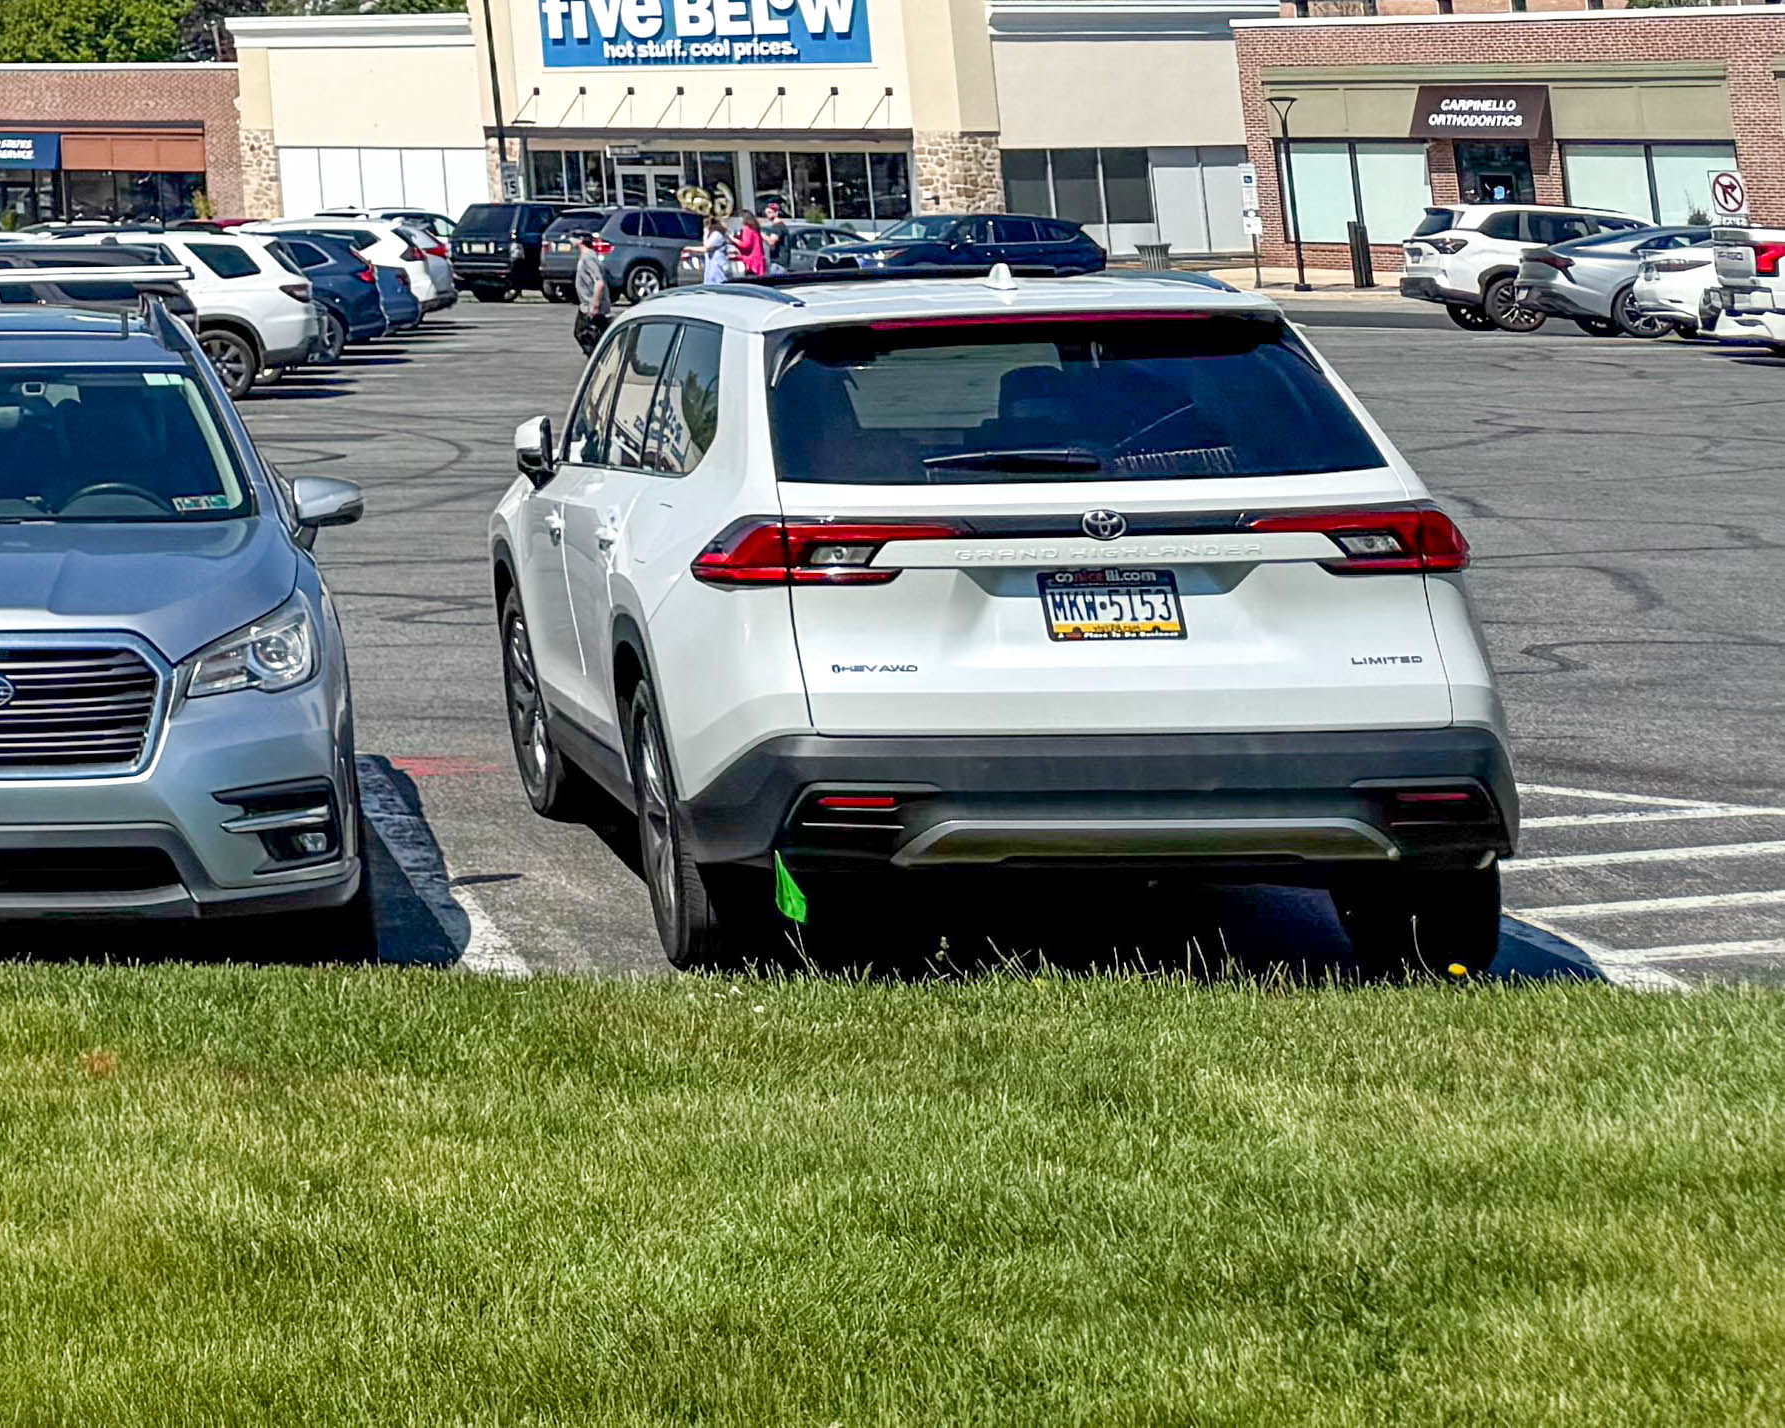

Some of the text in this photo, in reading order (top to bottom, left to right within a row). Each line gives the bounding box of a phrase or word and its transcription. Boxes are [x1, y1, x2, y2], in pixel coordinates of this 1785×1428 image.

[603, 37, 798, 60] hot stuff. cool prices.
[1440, 99, 1517, 112] CARPINELLO
[1428, 114, 1523, 126] ORTHODONTICS
[955, 543, 1263, 561] GRAND HIGHLANDER
[1351, 655, 1422, 665] LIMITED
